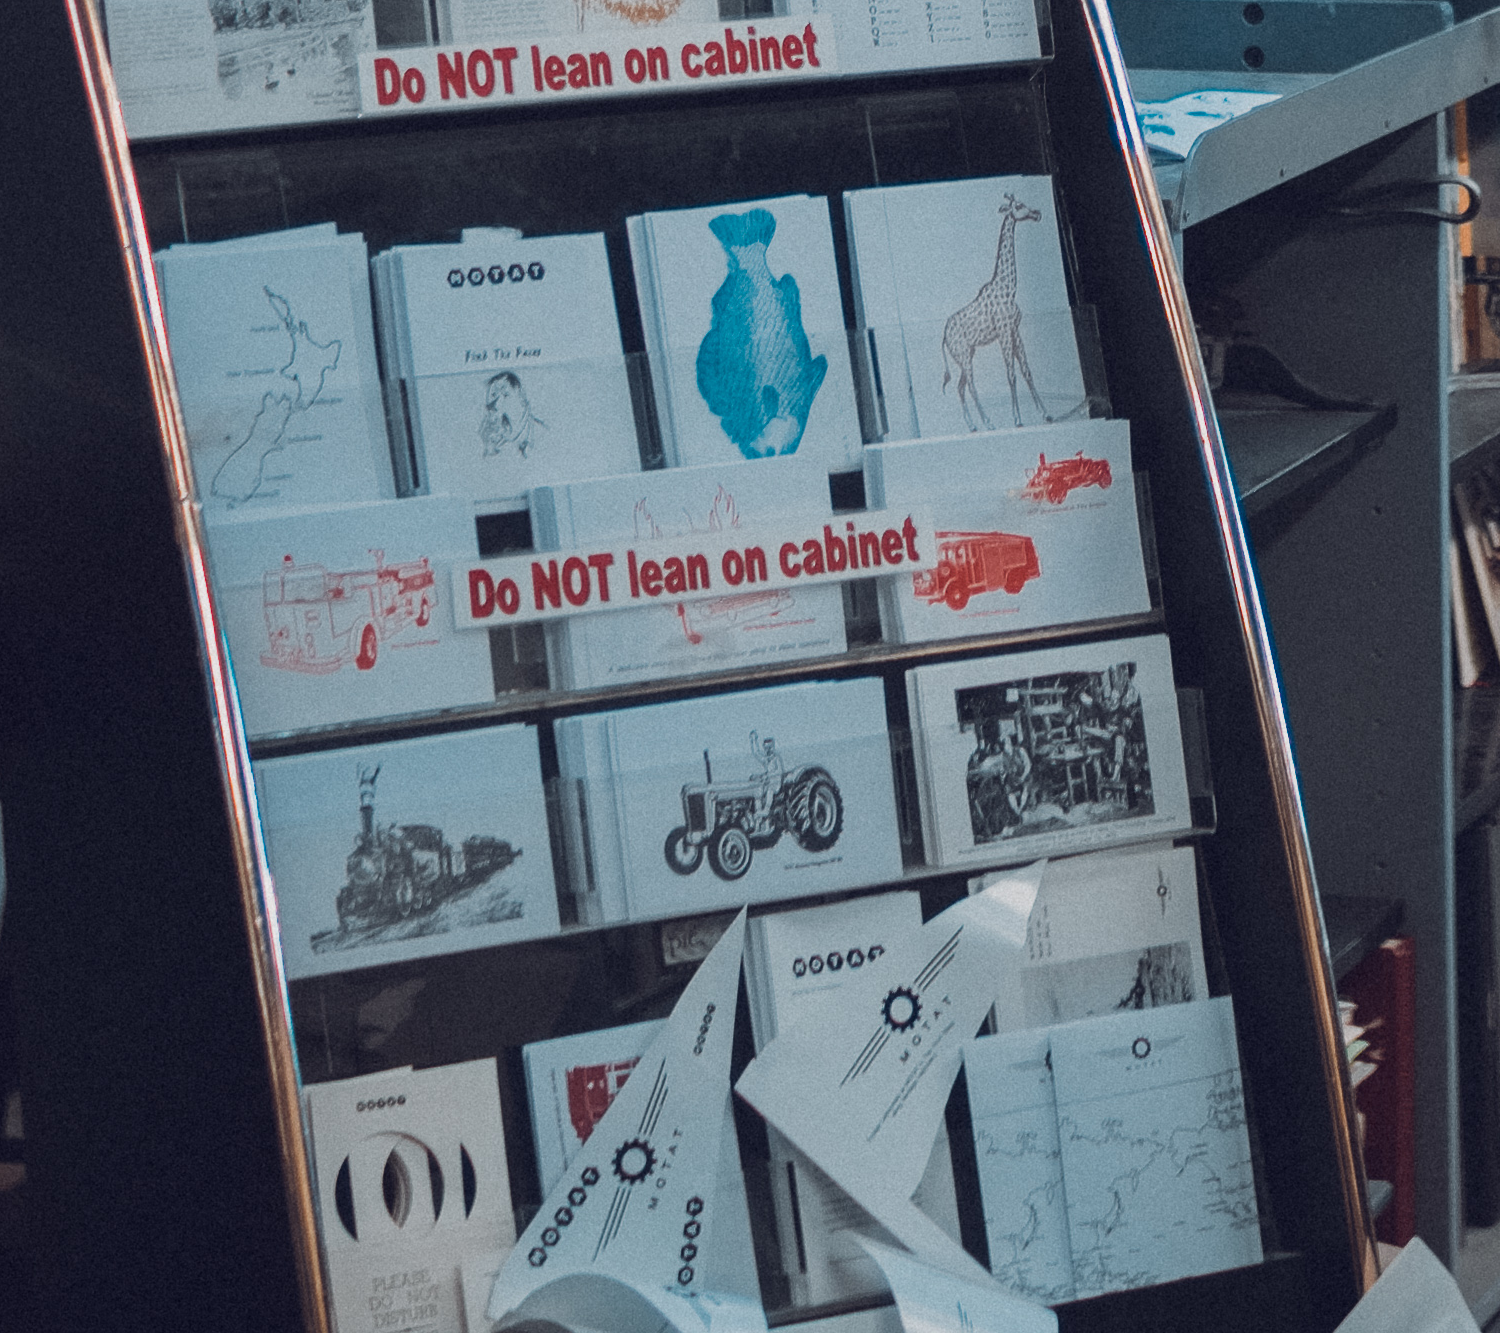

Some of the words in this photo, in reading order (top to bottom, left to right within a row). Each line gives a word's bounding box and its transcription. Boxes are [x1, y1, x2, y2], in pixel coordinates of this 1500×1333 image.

[374, 57, 426, 107] Do
[437, 47, 518, 100] NOT
[531, 44, 613, 93] lean
[624, 46, 669, 84] on
[681, 22, 820, 78] cabinet
[446, 261, 546, 289] MOTAT
[468, 568, 520, 619] Do
[531, 553, 615, 611] NOT
[627, 549, 710, 599] lean
[722, 545, 768, 586] on
[779, 514, 921, 578] cabinet
[648, 1127, 684, 1210] MOTAT
[677, 1195, 703, 1286] OTAT
[368, 1296, 394, 1312] DO
[407, 1286, 440, 1304] NOT
[371, 1268, 431, 1293] PLEASE
[373, 1303, 438, 1329] DISTURB
